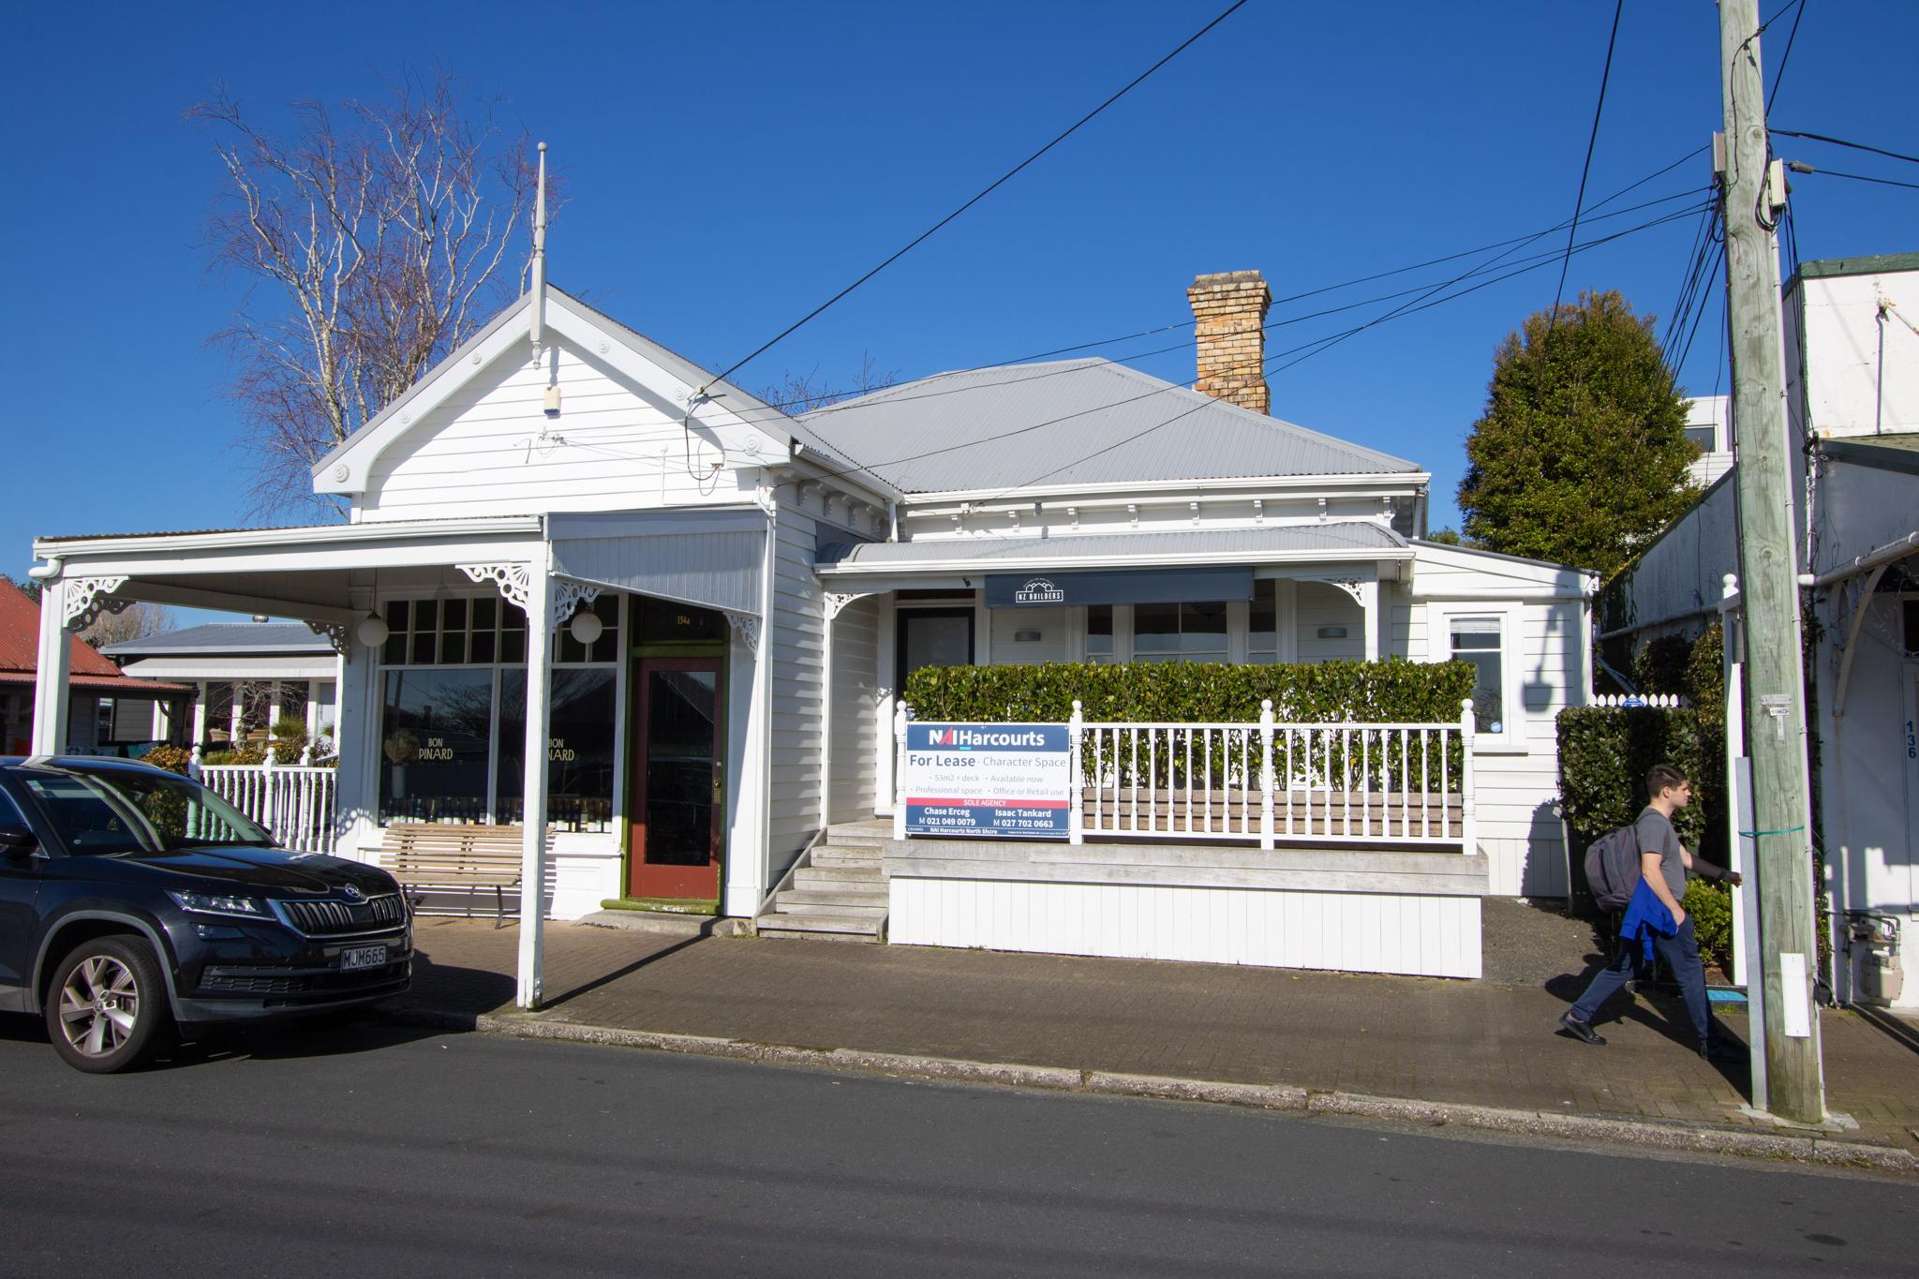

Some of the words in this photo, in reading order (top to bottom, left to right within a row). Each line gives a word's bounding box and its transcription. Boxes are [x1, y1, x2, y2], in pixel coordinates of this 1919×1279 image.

[1029, 592, 1061, 600] BUILDERS
[427, 737, 443, 748] BON
[959, 729, 1045, 746] Harcourts
[1906, 719, 1917, 759] 136
[418, 748, 454, 760] PINARD
[547, 748, 576, 761] NARD
[909, 754, 932, 767] For
[936, 754, 976, 767] Lease
[983, 755, 1033, 768] Character
[1034, 756, 1067, 769] Space
[990, 775, 1025, 784] Available
[1026, 776, 1044, 784] now
[915, 785, 960, 794] Professional
[961, 787, 983, 796] space
[992, 787, 1015, 796] Office
[1026, 788, 1048, 796] Retail
[981, 800, 1007, 808] AGENCY
[924, 807, 947, 815] Chase
[948, 807, 971, 818] Erceg
[995, 809, 1016, 817] Isaac
[1017, 809, 1052, 818] Tankard
[918, 817, 926, 825] M
[941, 818, 956, 826] 049
[957, 818, 976, 826] 0079
[993, 819, 1000, 827] M
[1001, 819, 1016, 828] 027
[1017, 820, 1032, 828] 702
[1033, 820, 1054, 829] 0663
